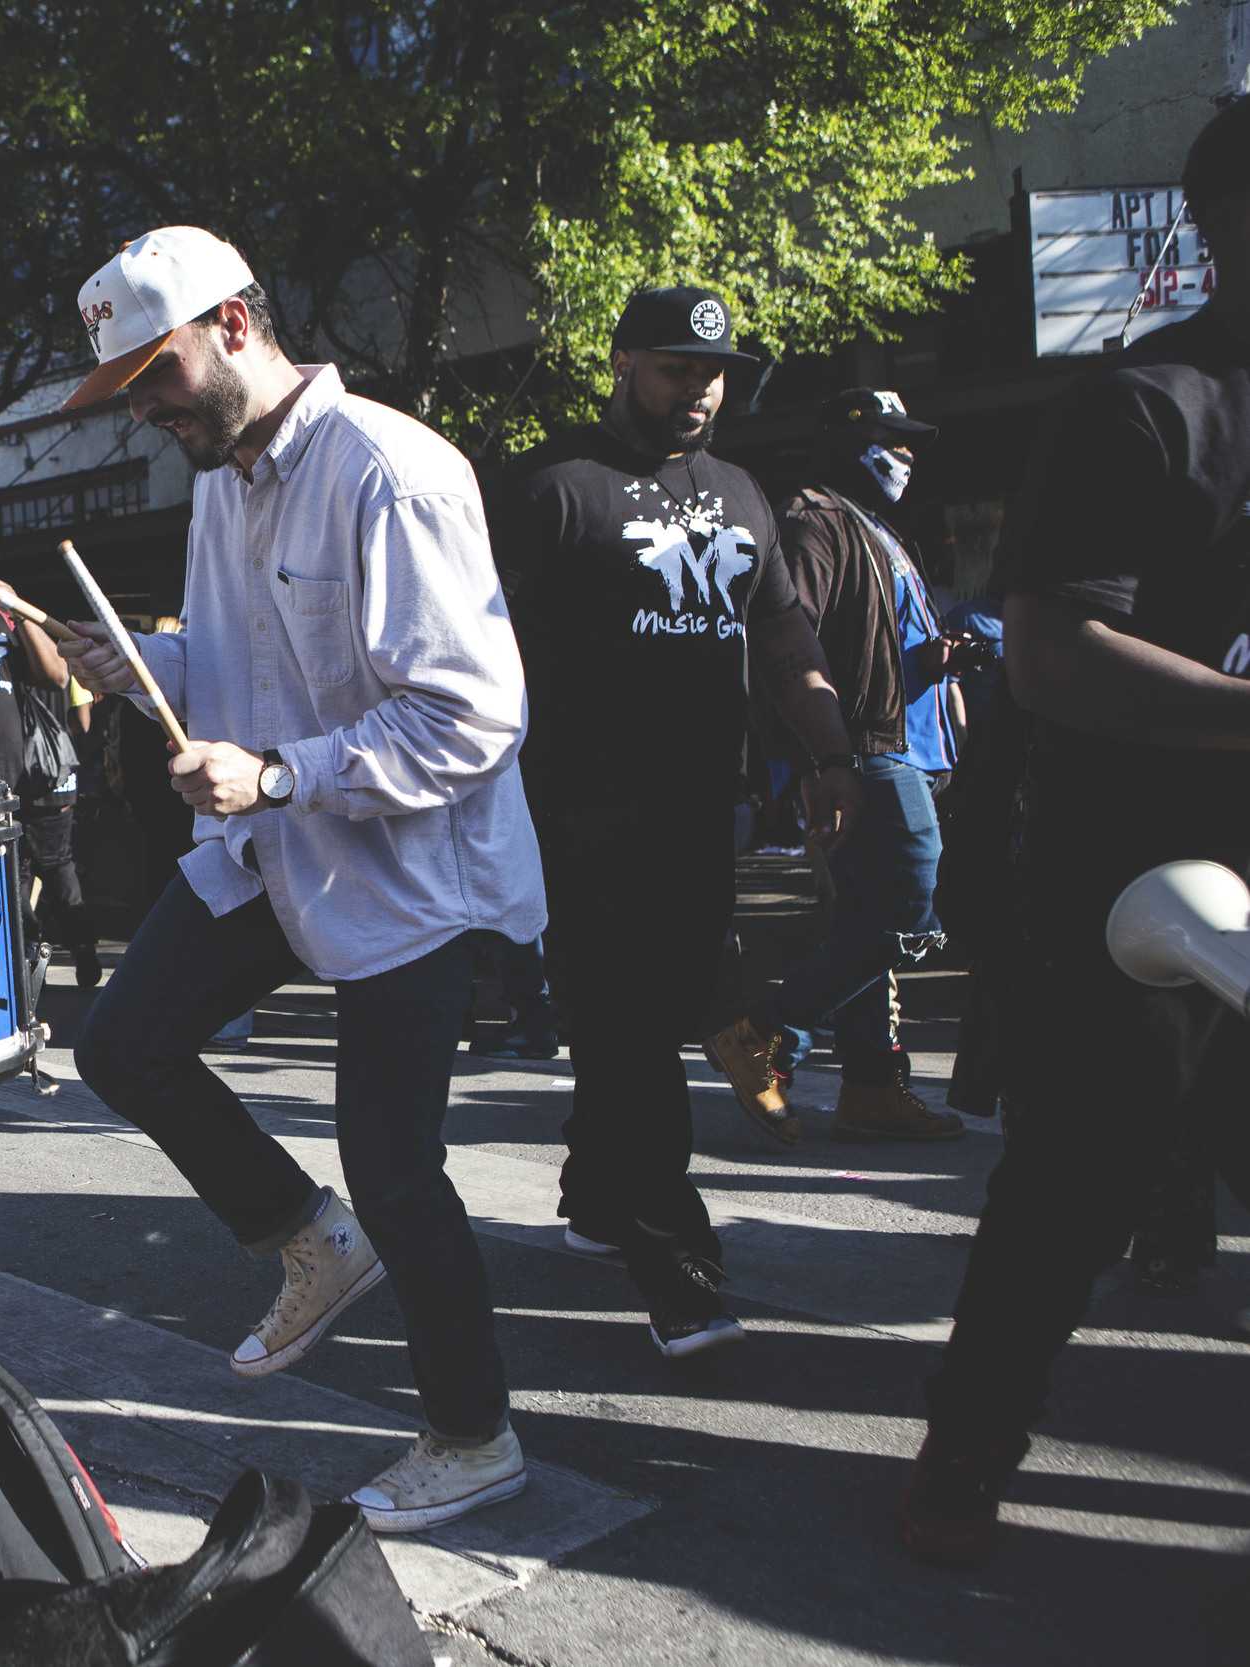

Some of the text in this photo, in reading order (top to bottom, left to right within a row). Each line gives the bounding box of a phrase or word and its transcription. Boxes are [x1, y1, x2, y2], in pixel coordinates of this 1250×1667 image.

[1113, 191, 1155, 228] APT
[1127, 231, 1180, 267] FOR
[632, 608, 708, 635] Music
